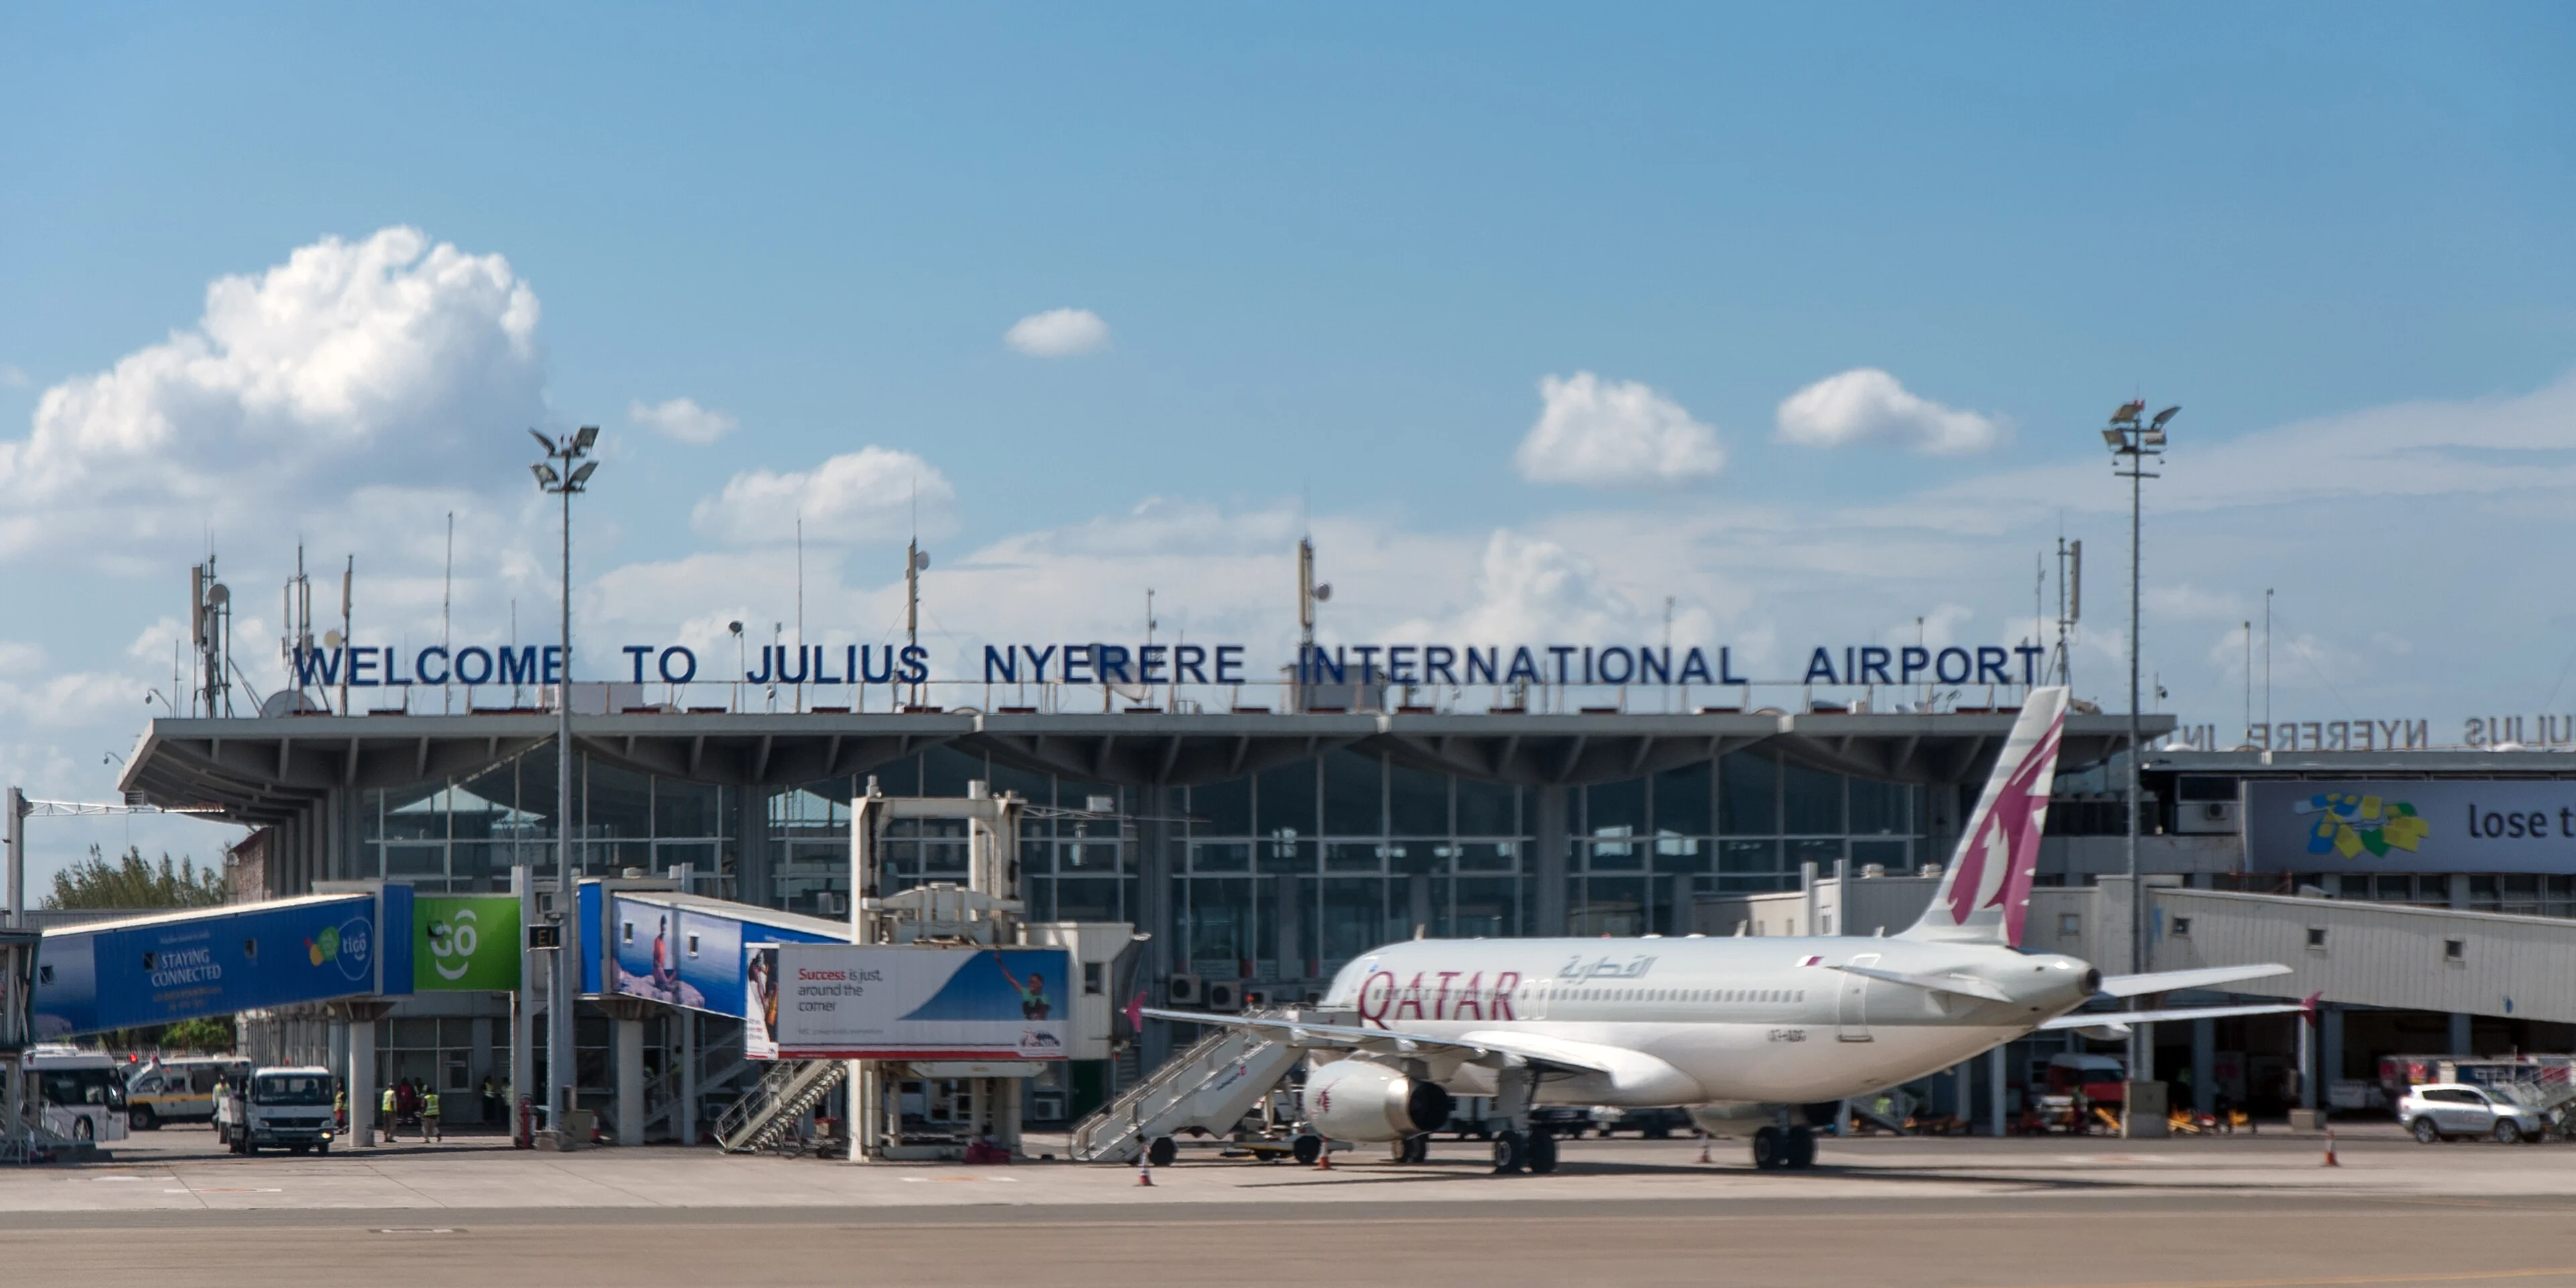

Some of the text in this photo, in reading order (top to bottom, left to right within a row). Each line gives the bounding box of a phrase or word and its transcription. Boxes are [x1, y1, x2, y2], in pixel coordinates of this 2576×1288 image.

[293, 645, 2044, 685] WELCOME TO JULIUS NYERERE INTERNATIONAL AIRPORT
[2469, 803, 2547, 838] lose
[162, 947, 210, 969] STAYING
[152, 963, 222, 987] CONNECTED
[798, 968, 846, 981] Success
[849, 969, 857, 981] is
[798, 984, 863, 997] around the
[1358, 971, 1521, 1030] QATAR
[798, 1002, 835, 1012] corner
